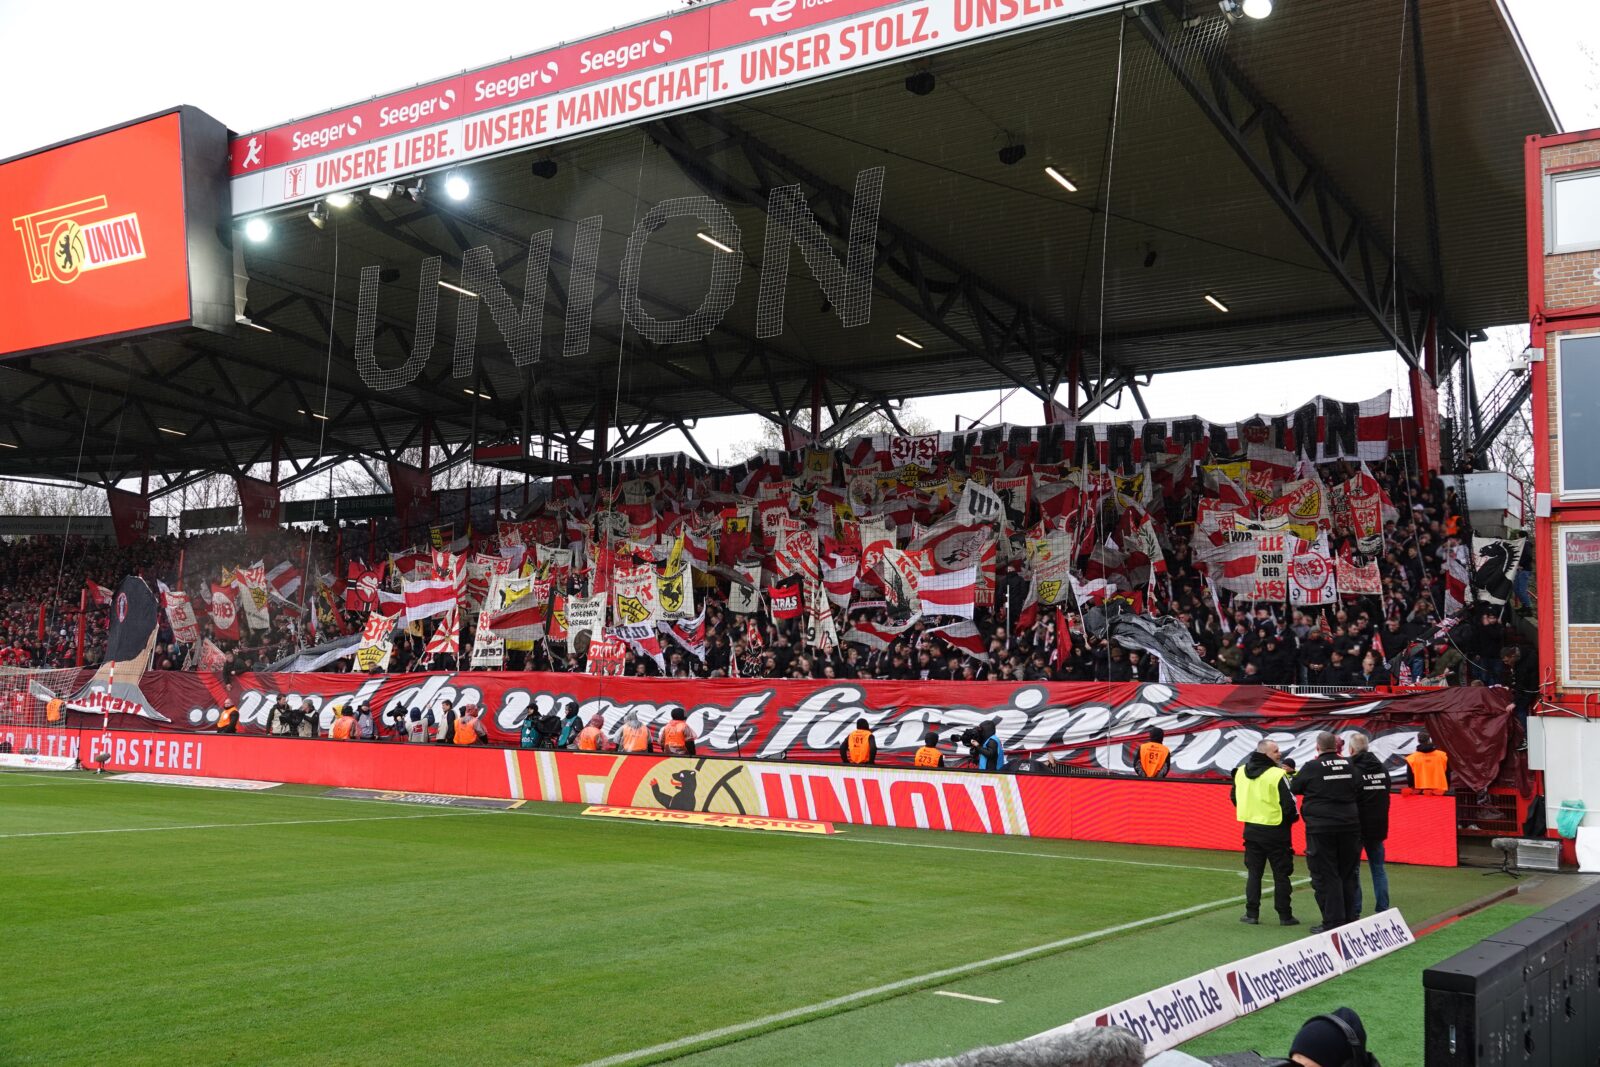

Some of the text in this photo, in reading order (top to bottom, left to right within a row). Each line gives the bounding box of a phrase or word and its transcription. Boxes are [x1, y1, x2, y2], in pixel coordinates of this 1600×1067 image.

[579, 36, 651, 75] Seeger
[315, 0, 1064, 189] UNSERE LIEBE. UNSERE MANNSCHAFT. UNSER STOLZ. UNS
[474, 68, 540, 102] Seeger
[379, 97, 438, 128] Seeger
[291, 122, 346, 151] Seeger
[84, 217, 142, 265] UNION
[355, 166, 885, 391] UNION
[1230, 531, 1253, 543] WIR
[1262, 554, 1283, 564] SIND
[1262, 567, 1280, 577] DER
[24, 733, 80, 760] ALTEN
[90, 733, 202, 770] FÖRSTEREI
[918, 755, 932, 764] 273
[1149, 752, 1159, 760] 61
[618, 808, 816, 830] LOTTO LOTTO
[1345, 919, 1409, 959] ibr-berlin.de
[1245, 949, 1335, 1002] Ingenieurbüro
